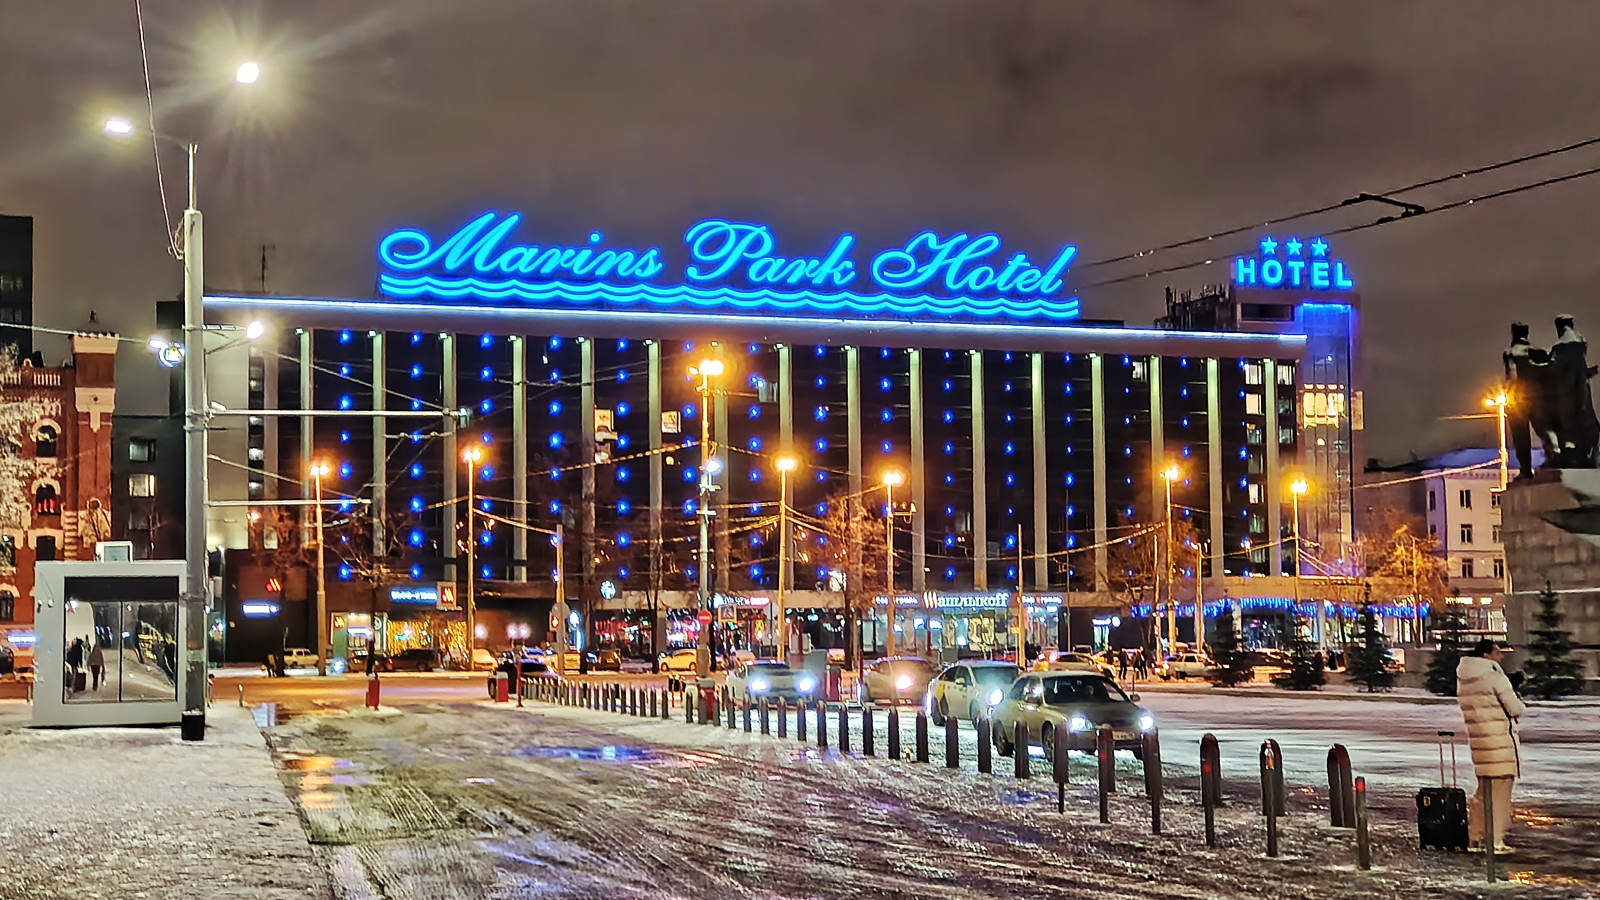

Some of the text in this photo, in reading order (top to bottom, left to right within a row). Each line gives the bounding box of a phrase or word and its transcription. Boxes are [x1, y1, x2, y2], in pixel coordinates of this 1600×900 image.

[380, 210, 1077, 295] Marins Park Hotel
[1236, 257, 1354, 288] HOTEL
